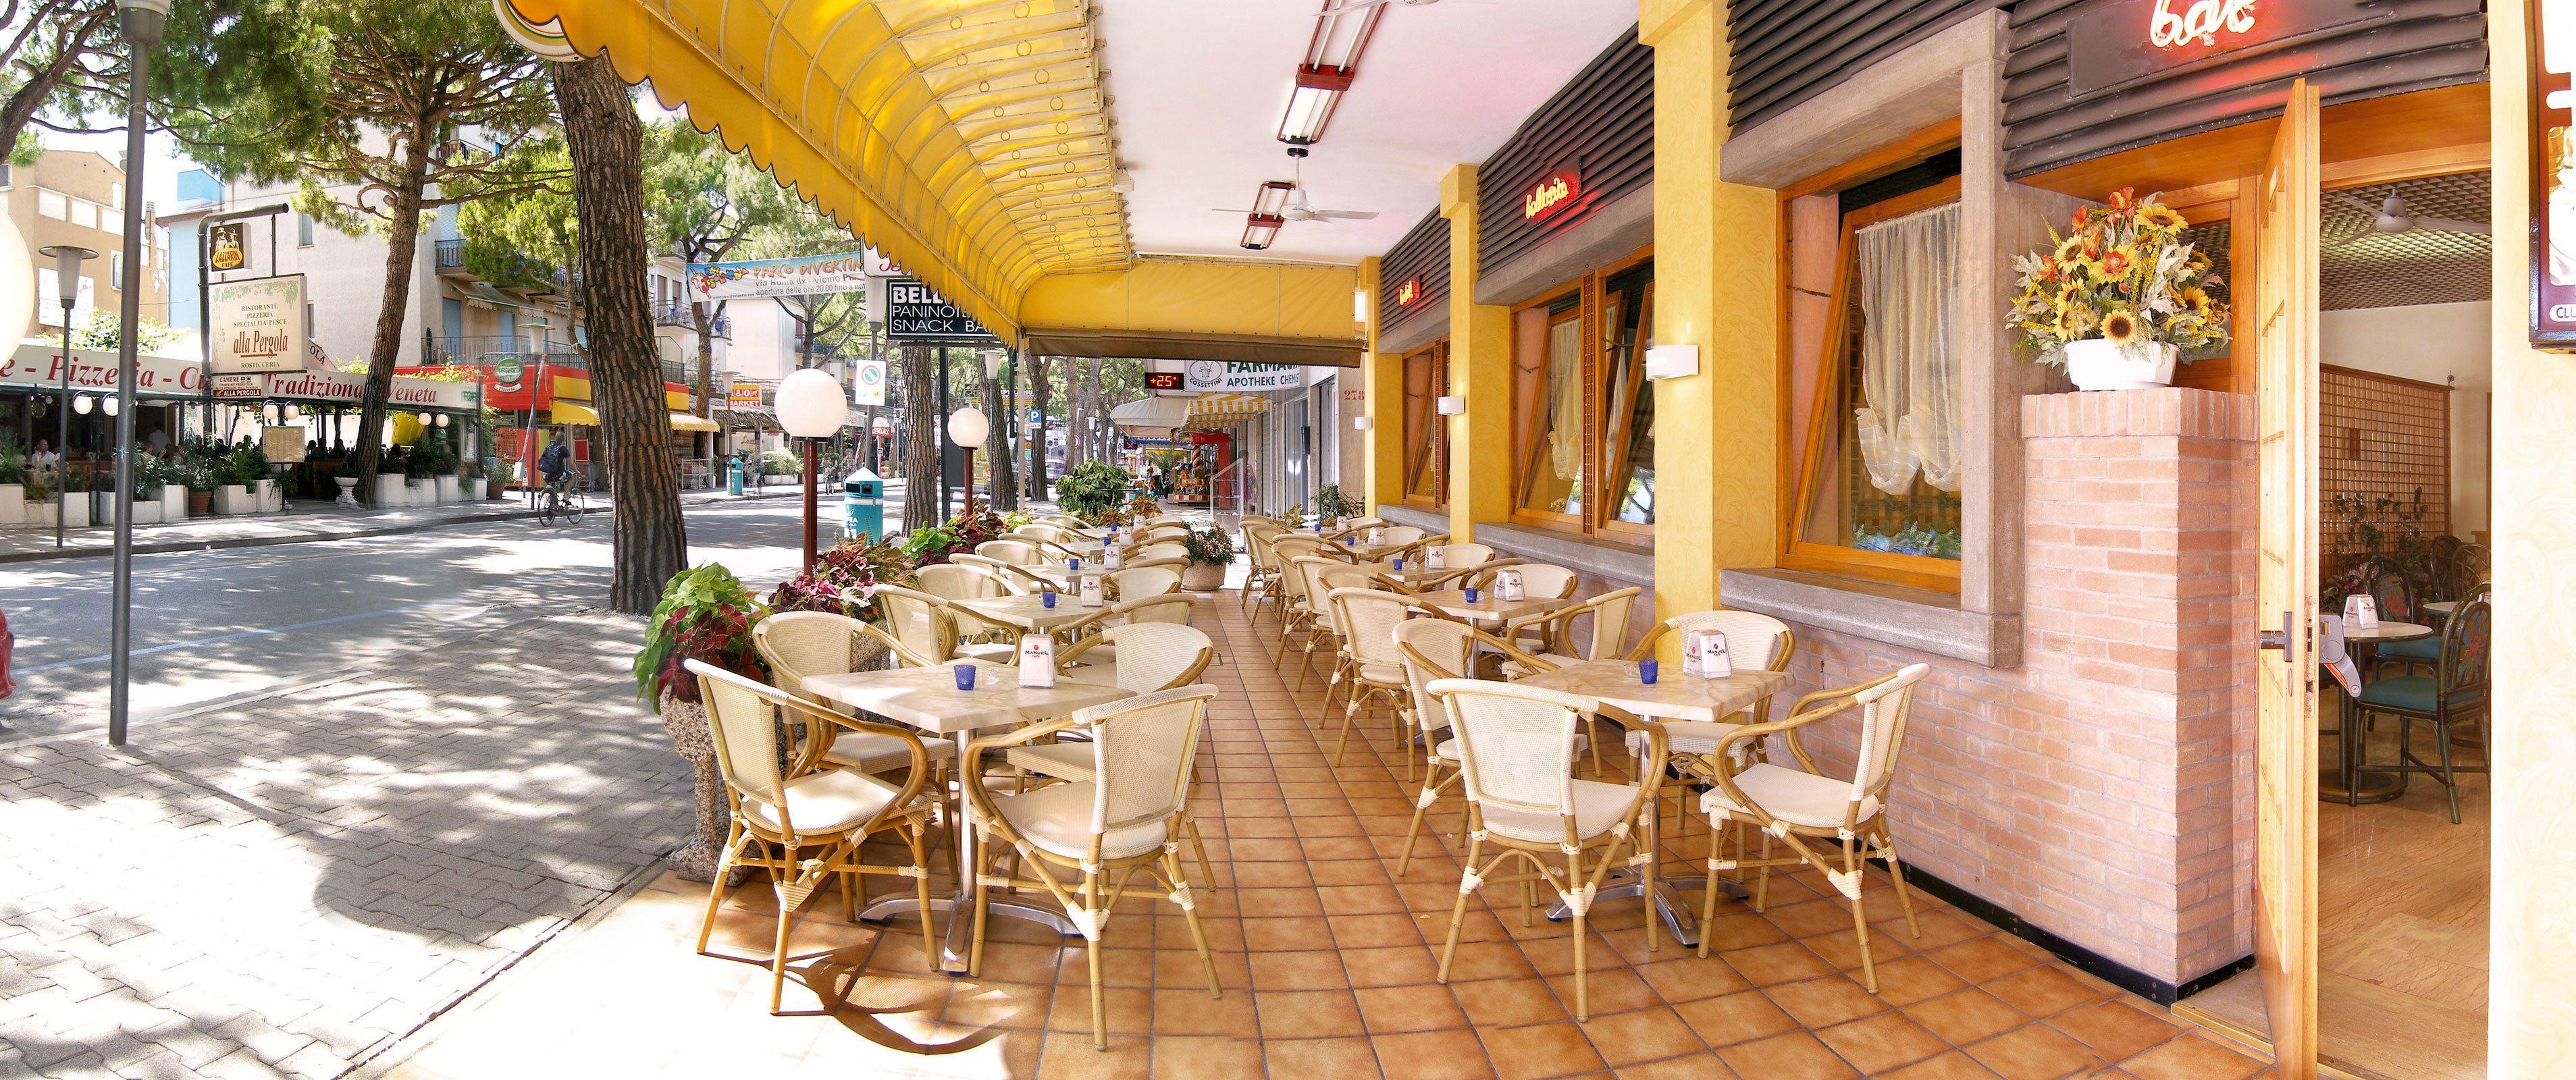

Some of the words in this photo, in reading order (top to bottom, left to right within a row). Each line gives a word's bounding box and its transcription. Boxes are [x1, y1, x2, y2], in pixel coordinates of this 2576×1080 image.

[2150, 0, 2258, 47] bar
[753, 263, 794, 279] PARCO
[770, 278, 794, 286] Roma
[797, 277, 807, 285] dx
[756, 288, 784, 297] apertura
[786, 286, 801, 294] dalle
[816, 284, 833, 292] 20.00
[893, 286, 943, 304] BELL
[242, 303, 278, 311] RISTORANTE
[893, 319, 953, 332] SNACK
[233, 331, 251, 354] alla
[253, 328, 288, 358] Pergola
[45, 354, 154, 387] Pizzeia
[267, 374, 363, 398] Tradiziona
[1189, 377, 1223, 388] COSSETTINI
[1227, 376, 1275, 387] APOTHEKE
[1344, 389, 1365, 400] 278
